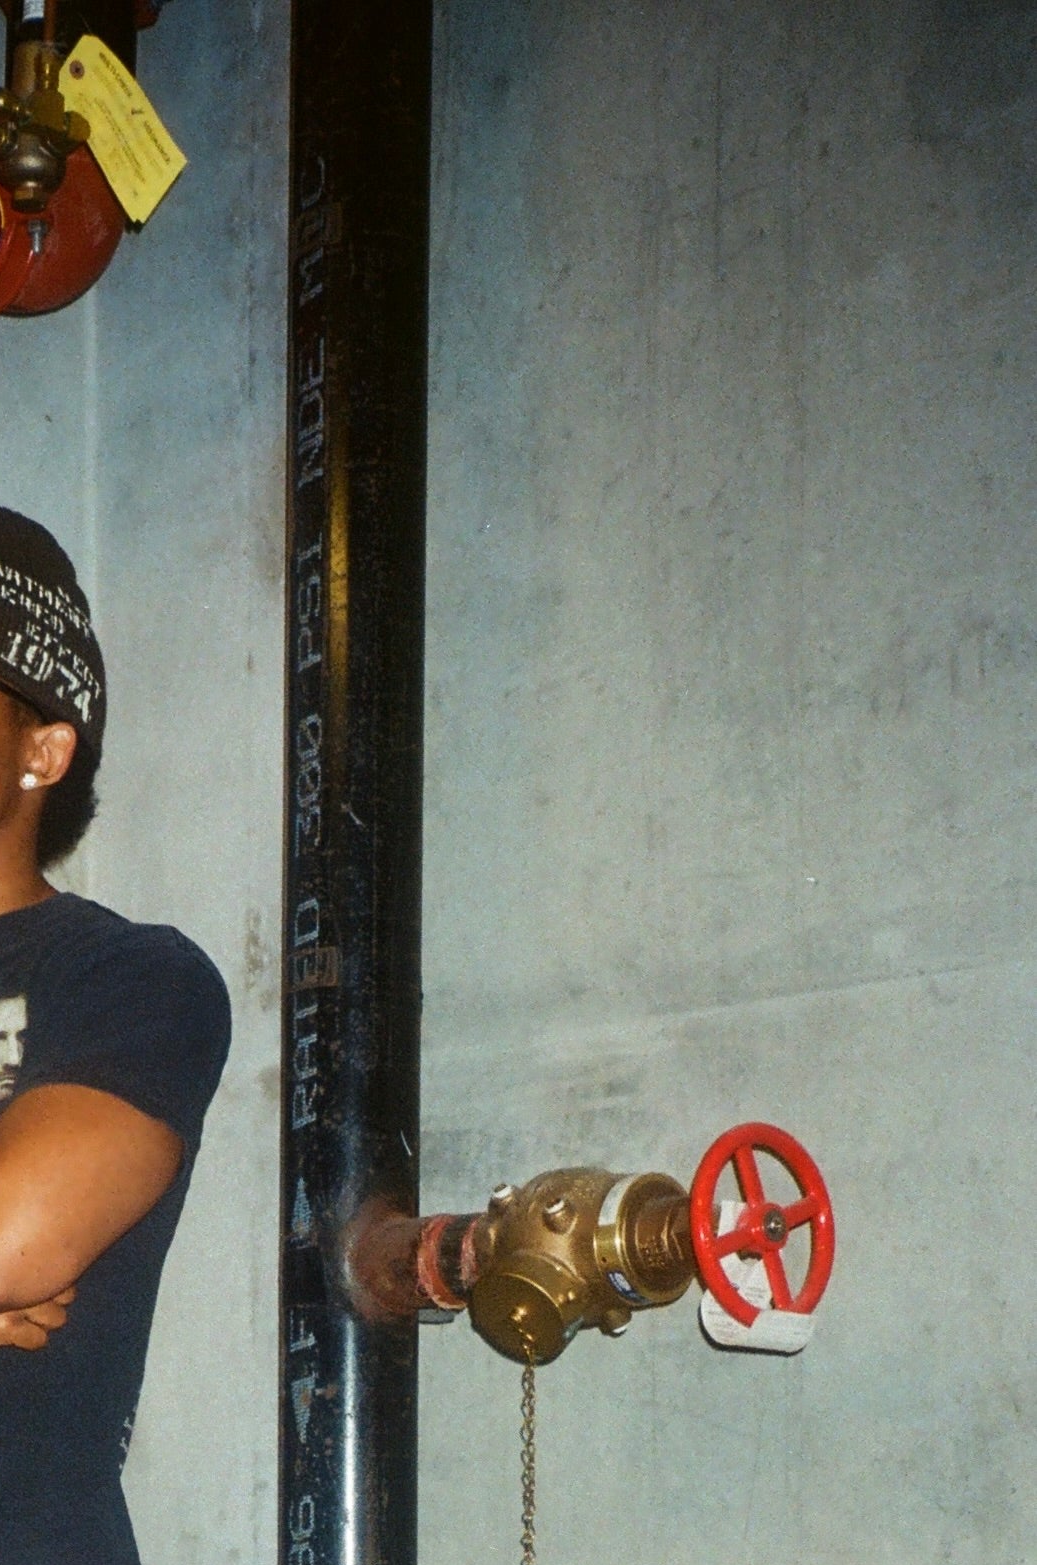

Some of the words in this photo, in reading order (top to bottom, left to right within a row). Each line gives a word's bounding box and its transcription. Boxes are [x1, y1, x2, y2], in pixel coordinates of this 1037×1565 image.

[296, 336, 326, 491] NDE
[295, 530, 324, 673] PSI
[291, 897, 321, 1131] RATED
